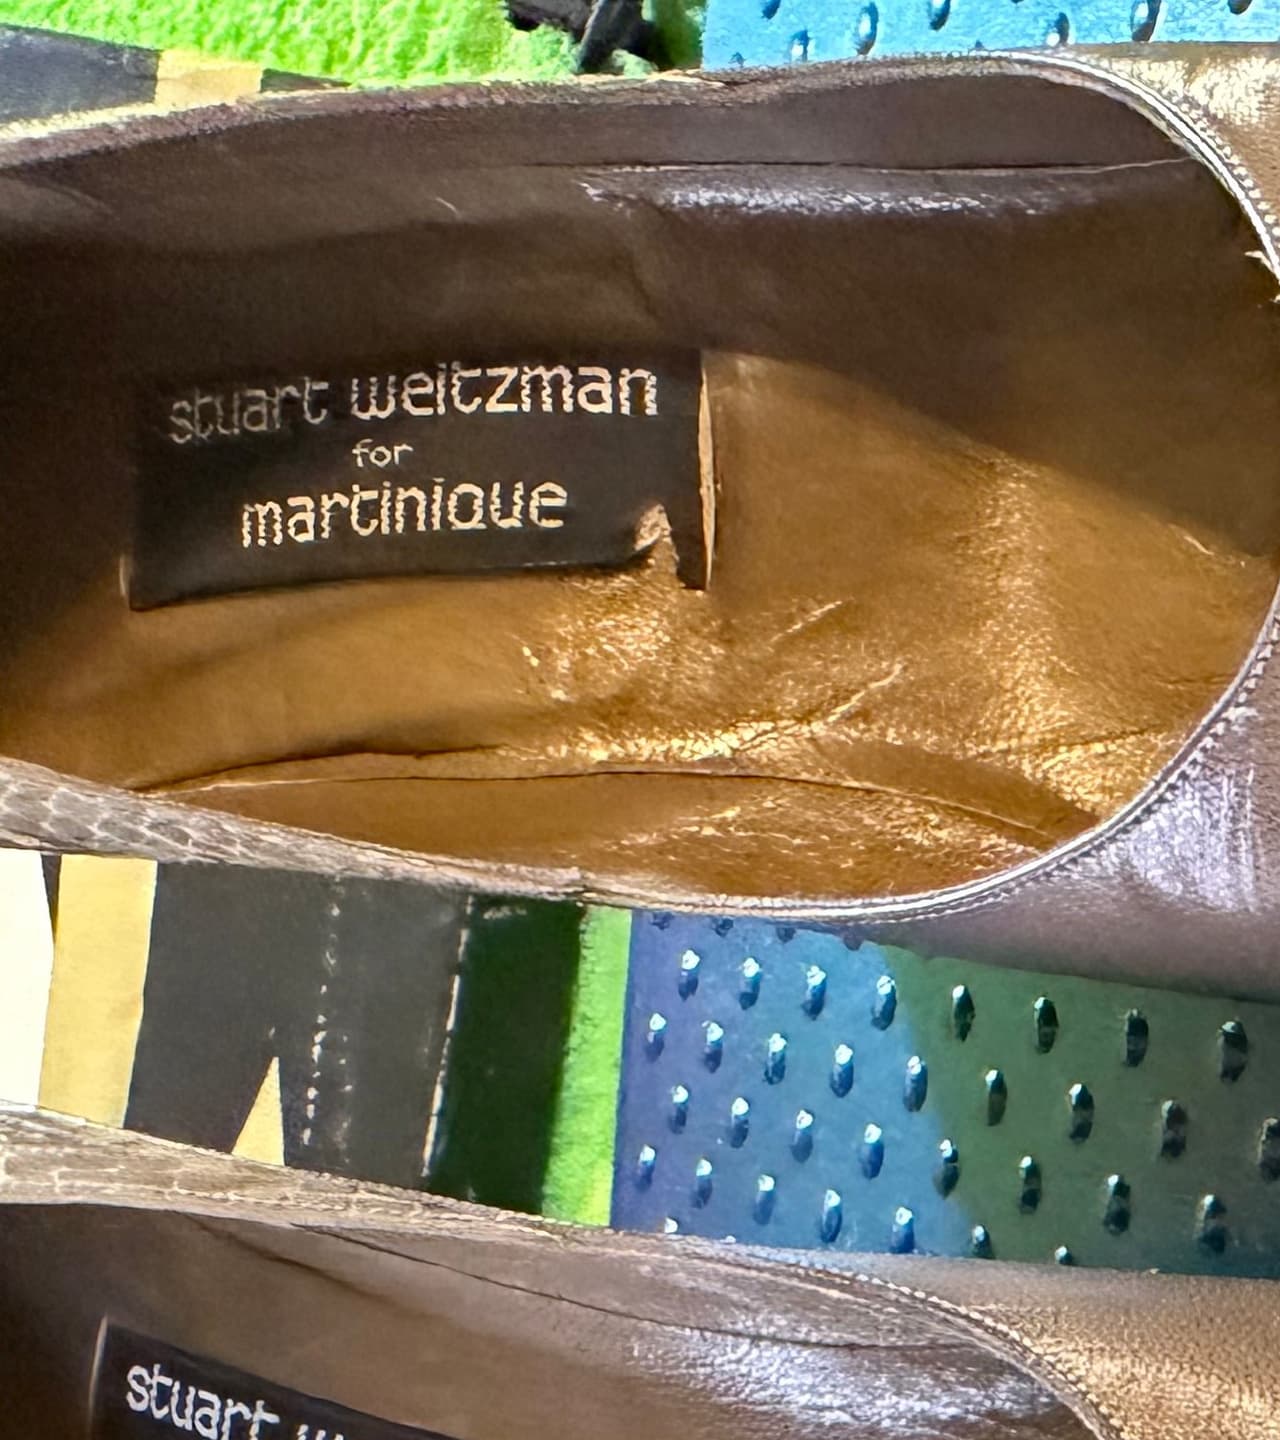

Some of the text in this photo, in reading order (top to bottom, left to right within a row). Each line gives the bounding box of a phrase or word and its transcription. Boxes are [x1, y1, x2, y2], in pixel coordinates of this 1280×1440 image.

[169, 361, 659, 443] stuart weitzman
[352, 438, 413, 468] for
[240, 478, 568, 547] martinique
